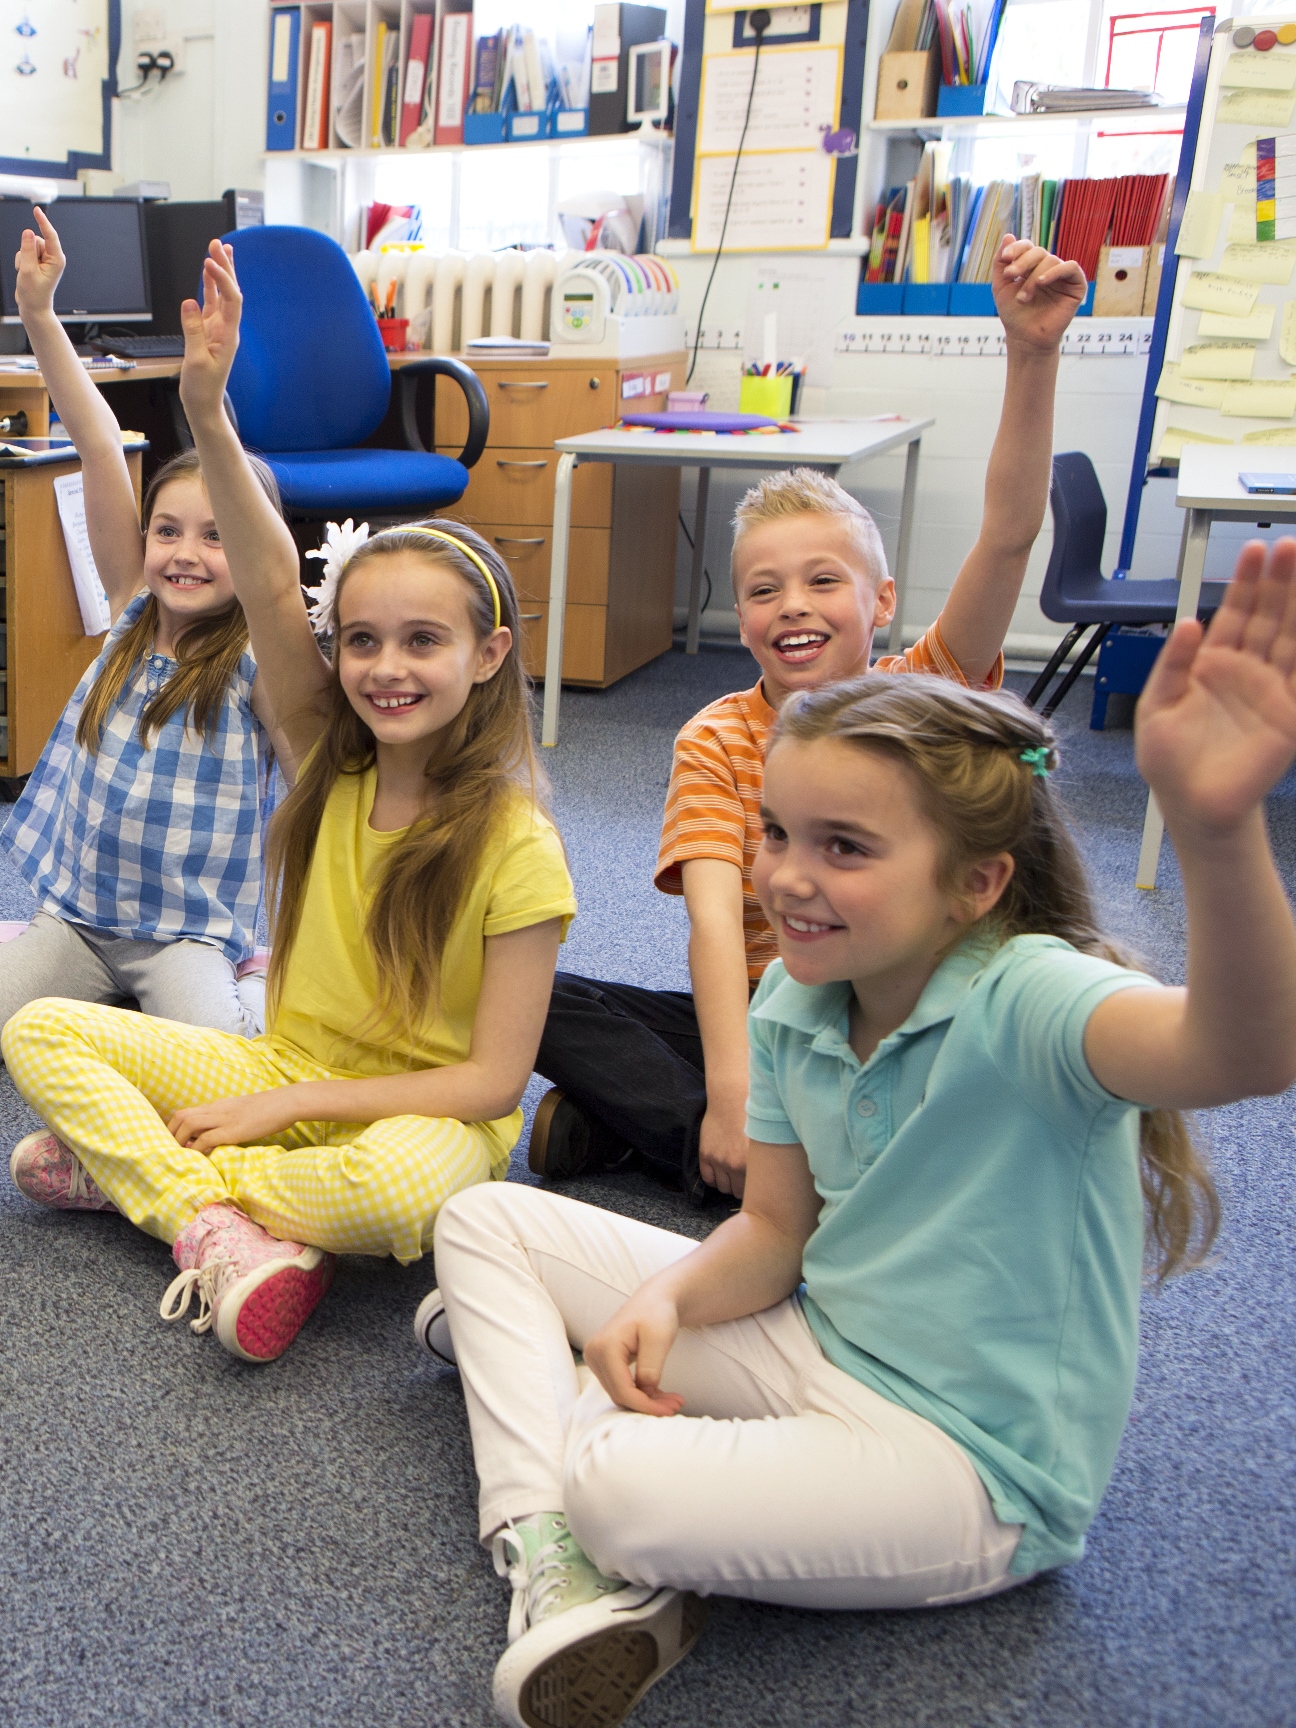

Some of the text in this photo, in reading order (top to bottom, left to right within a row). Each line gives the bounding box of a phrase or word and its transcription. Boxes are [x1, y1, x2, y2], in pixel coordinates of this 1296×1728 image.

[843, 333, 856, 342] 10
[862, 333, 873, 342] 11
[881, 333, 892, 342] 12
[899, 333, 910, 342] 13
[918, 333, 930, 342] 14
[938, 336, 950, 345] 15
[958, 336, 969, 345] 16
[977, 335, 989, 344] 17
[1077, 334, 1091, 343] 22
[1098, 333, 1112, 343] 23
[1119, 333, 1133, 343] 24
